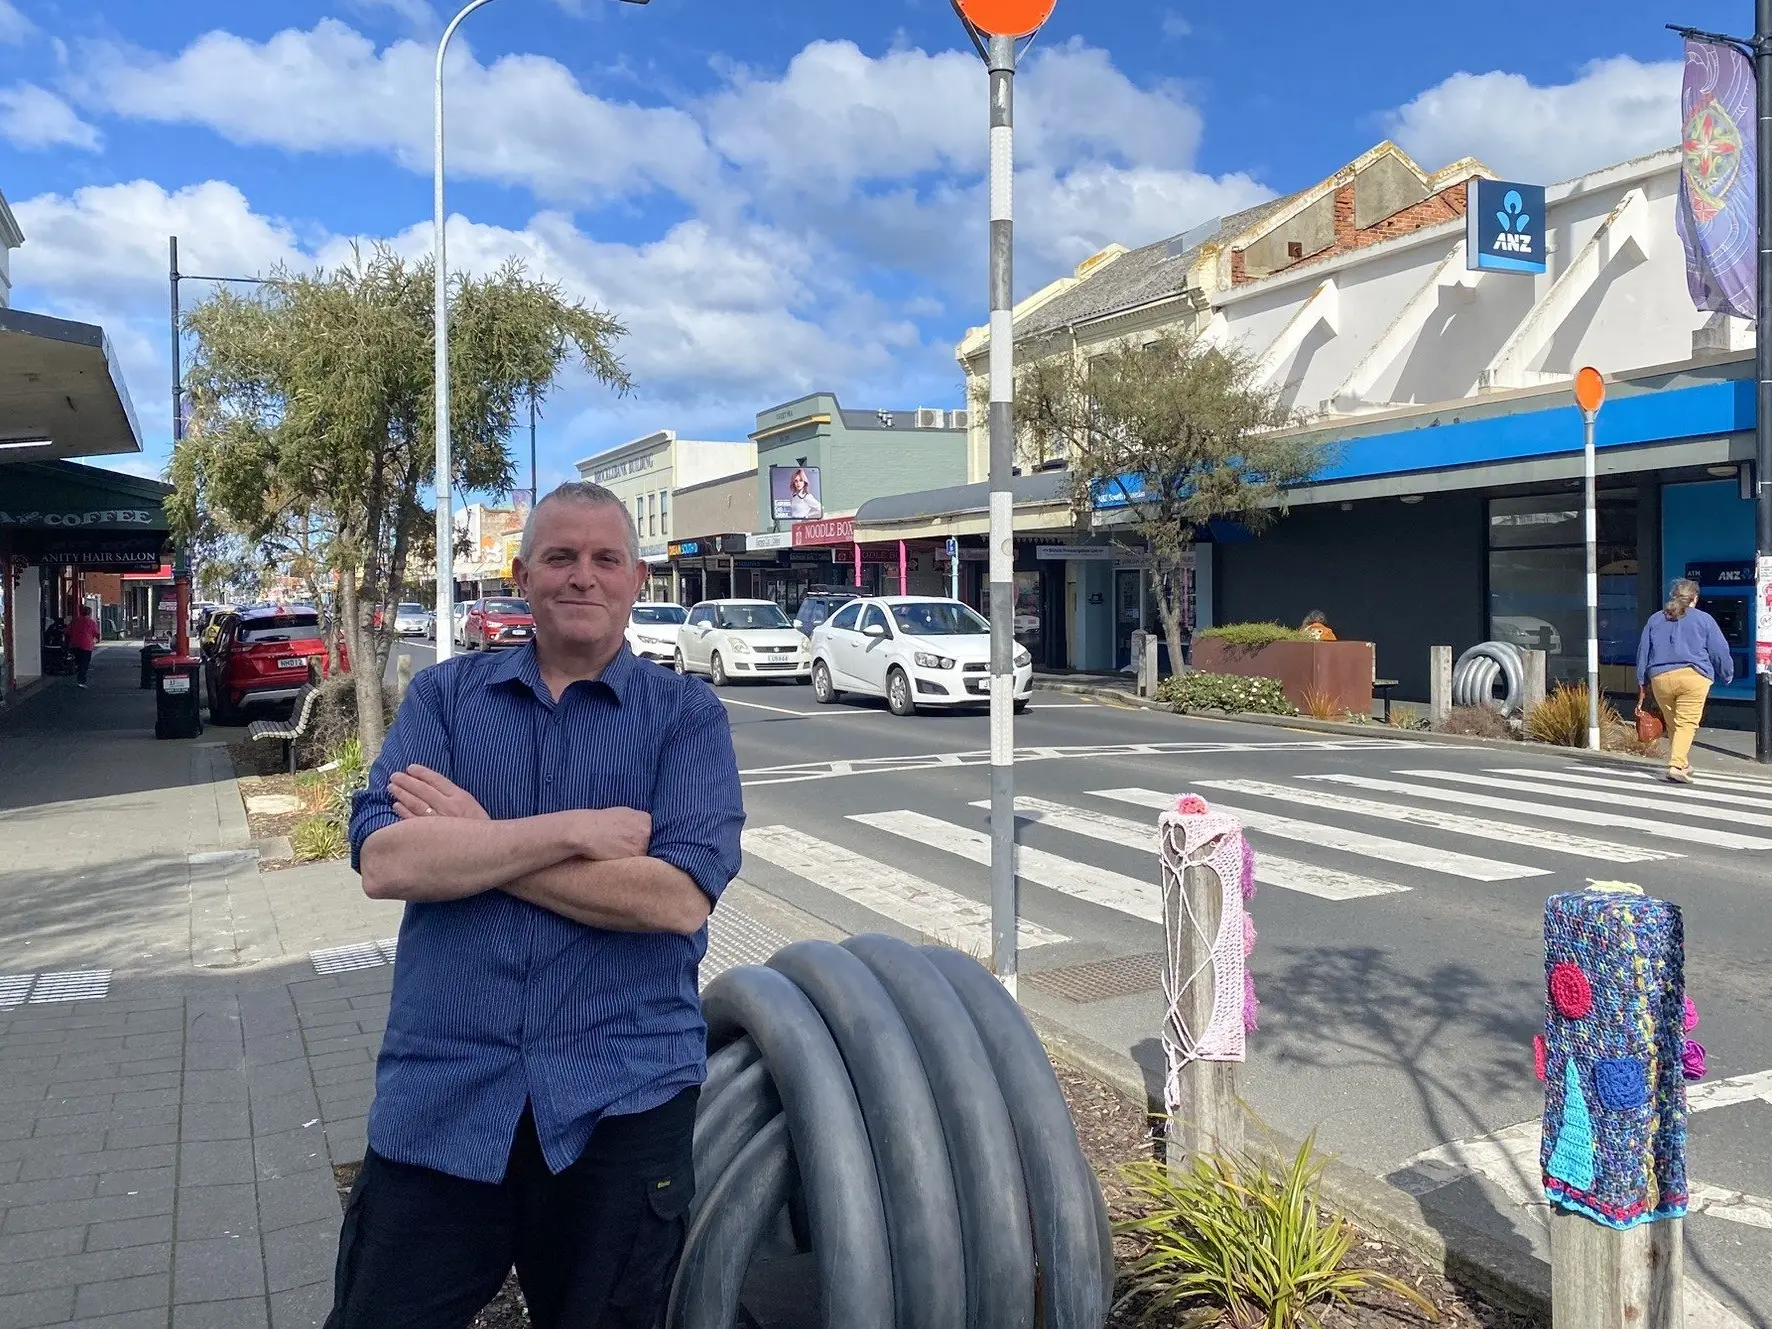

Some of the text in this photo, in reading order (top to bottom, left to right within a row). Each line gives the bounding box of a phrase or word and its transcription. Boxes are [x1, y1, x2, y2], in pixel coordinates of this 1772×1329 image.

[1493, 232, 1531, 253] ANZ
[629, 453, 653, 474] BUILDING
[44, 510, 152, 526] COFFEE
[805, 521, 854, 539] NOODLE BOX
[83, 553, 113, 562] HAIR
[115, 552, 156, 561] SALON
[1718, 570, 1740, 580] ANZ
